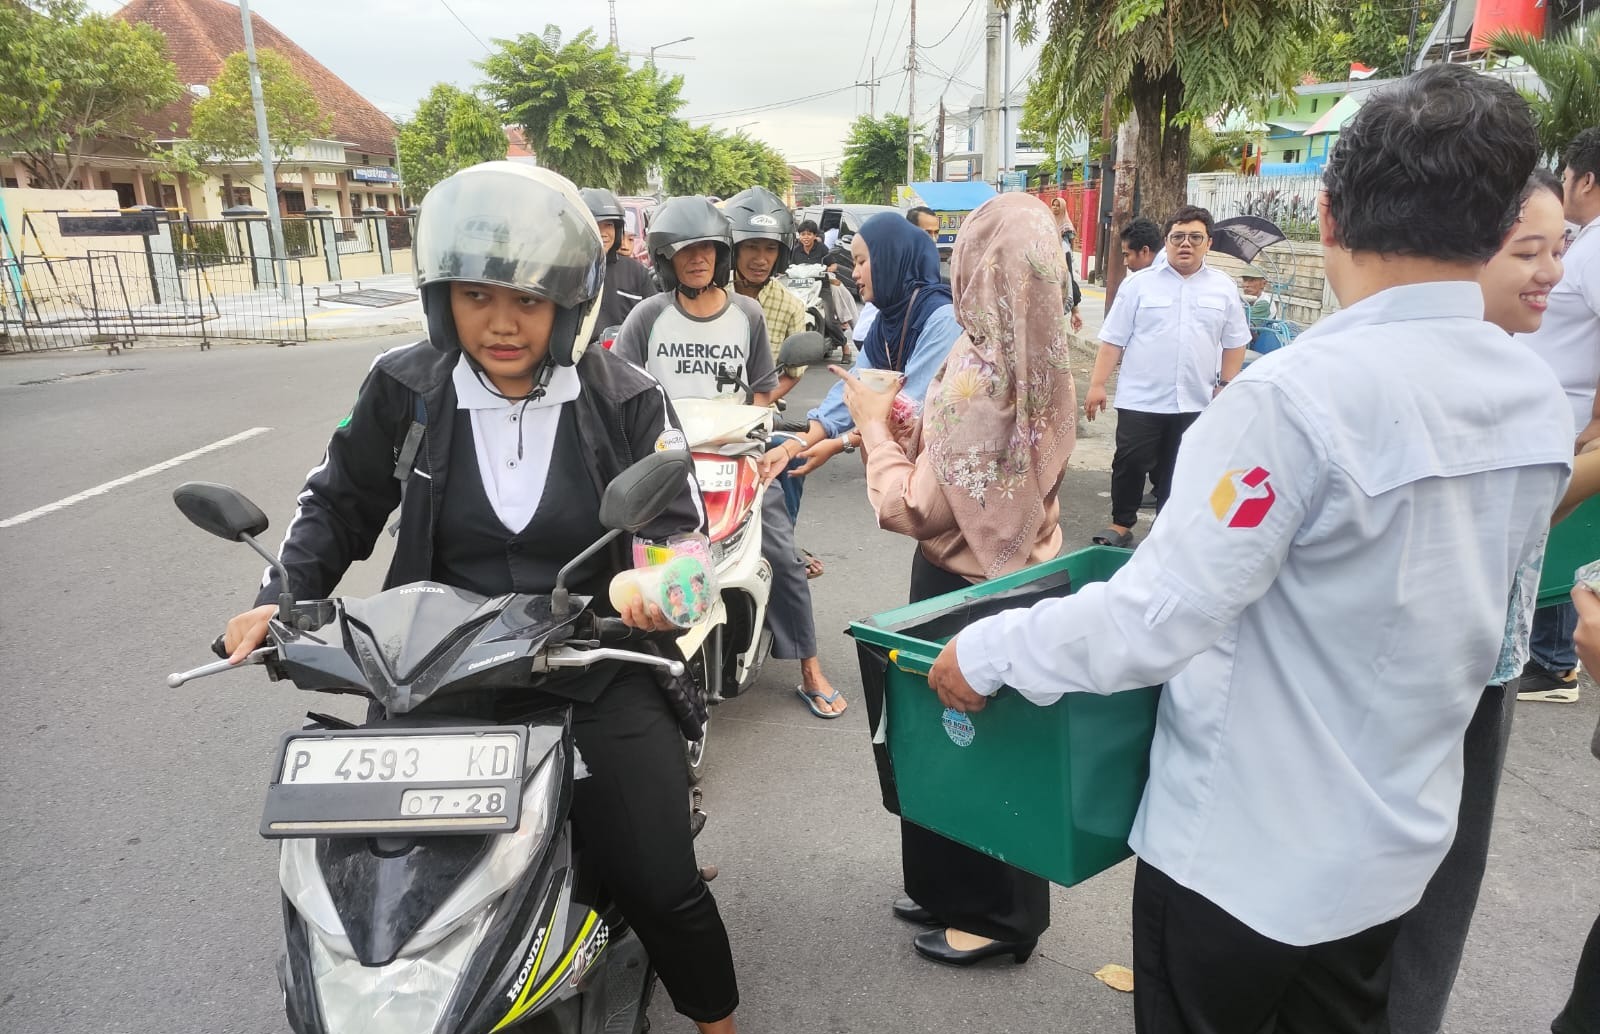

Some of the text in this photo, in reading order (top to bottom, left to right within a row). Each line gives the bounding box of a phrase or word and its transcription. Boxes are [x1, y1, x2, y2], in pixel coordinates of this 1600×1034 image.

[656, 342, 744, 359] AMERICAN
[716, 464, 735, 476] JU
[400, 586, 445, 595] HONDA
[290, 745, 510, 782] P 4593 KD
[506, 927, 547, 1002] HONDA
